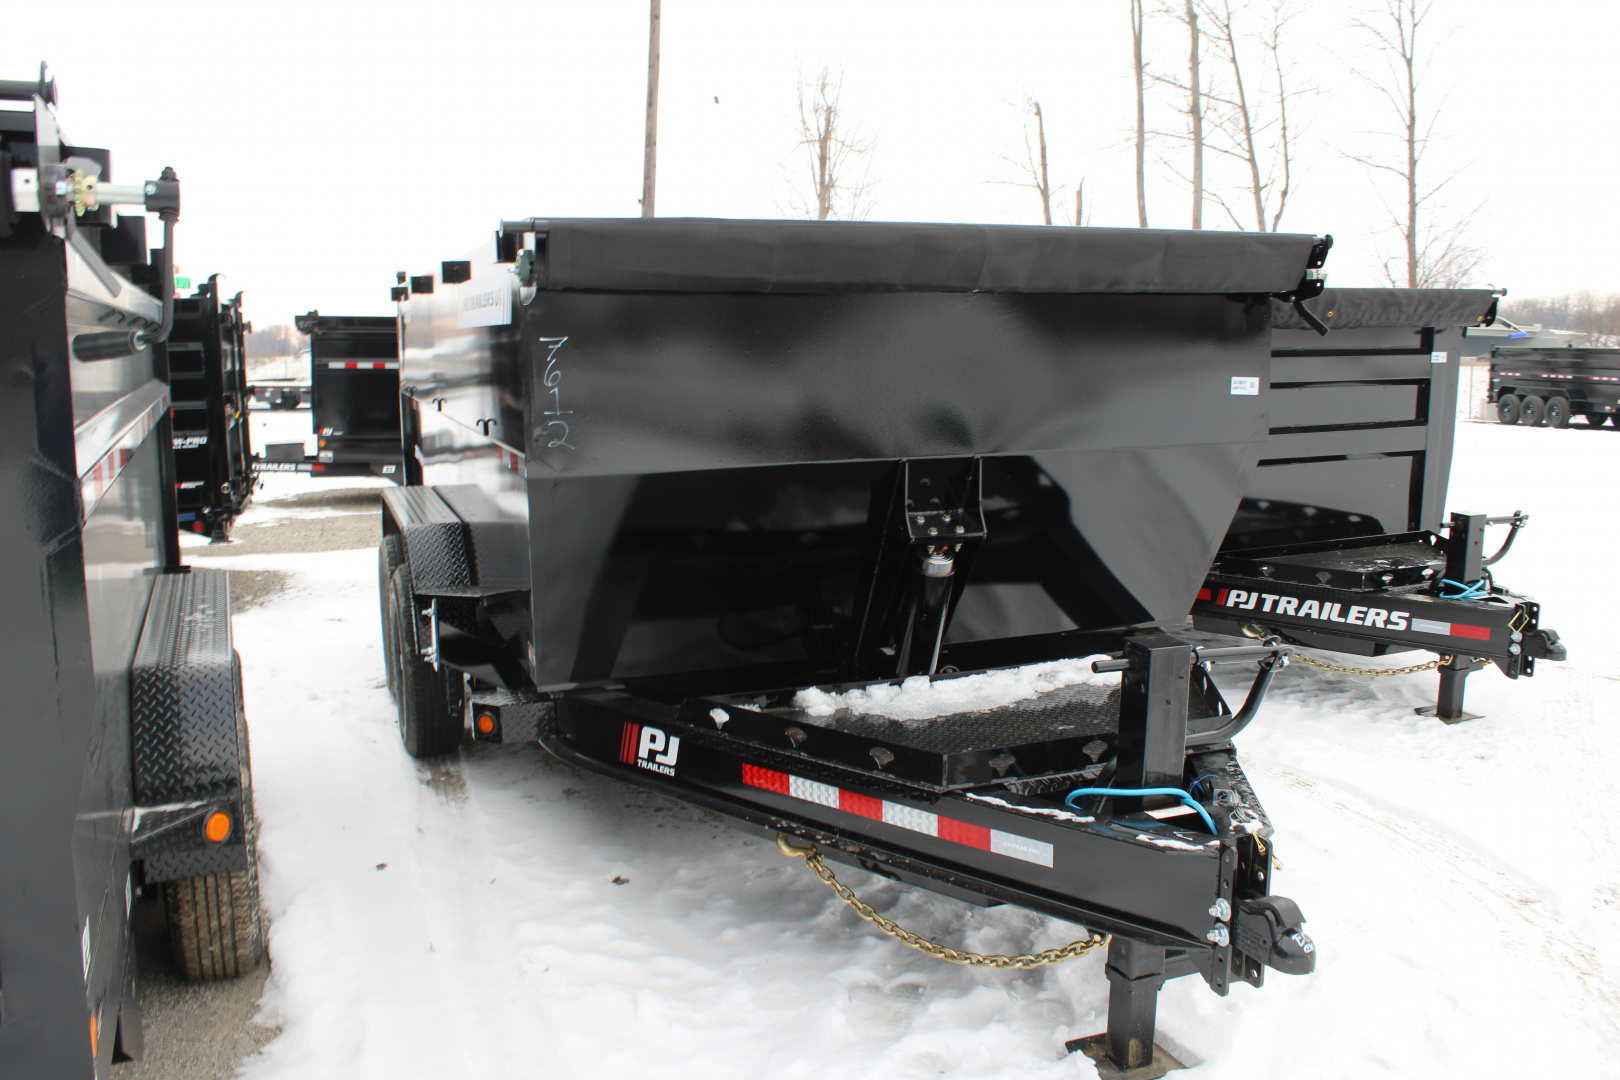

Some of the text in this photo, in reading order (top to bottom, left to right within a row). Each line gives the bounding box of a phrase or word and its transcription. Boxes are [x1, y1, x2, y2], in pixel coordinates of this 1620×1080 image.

[539, 336, 575, 450] 7612
[1226, 589, 1410, 631] PJ TRAILERS
[638, 725, 680, 767] PJ
[637, 758, 676, 777] TRAILERS
